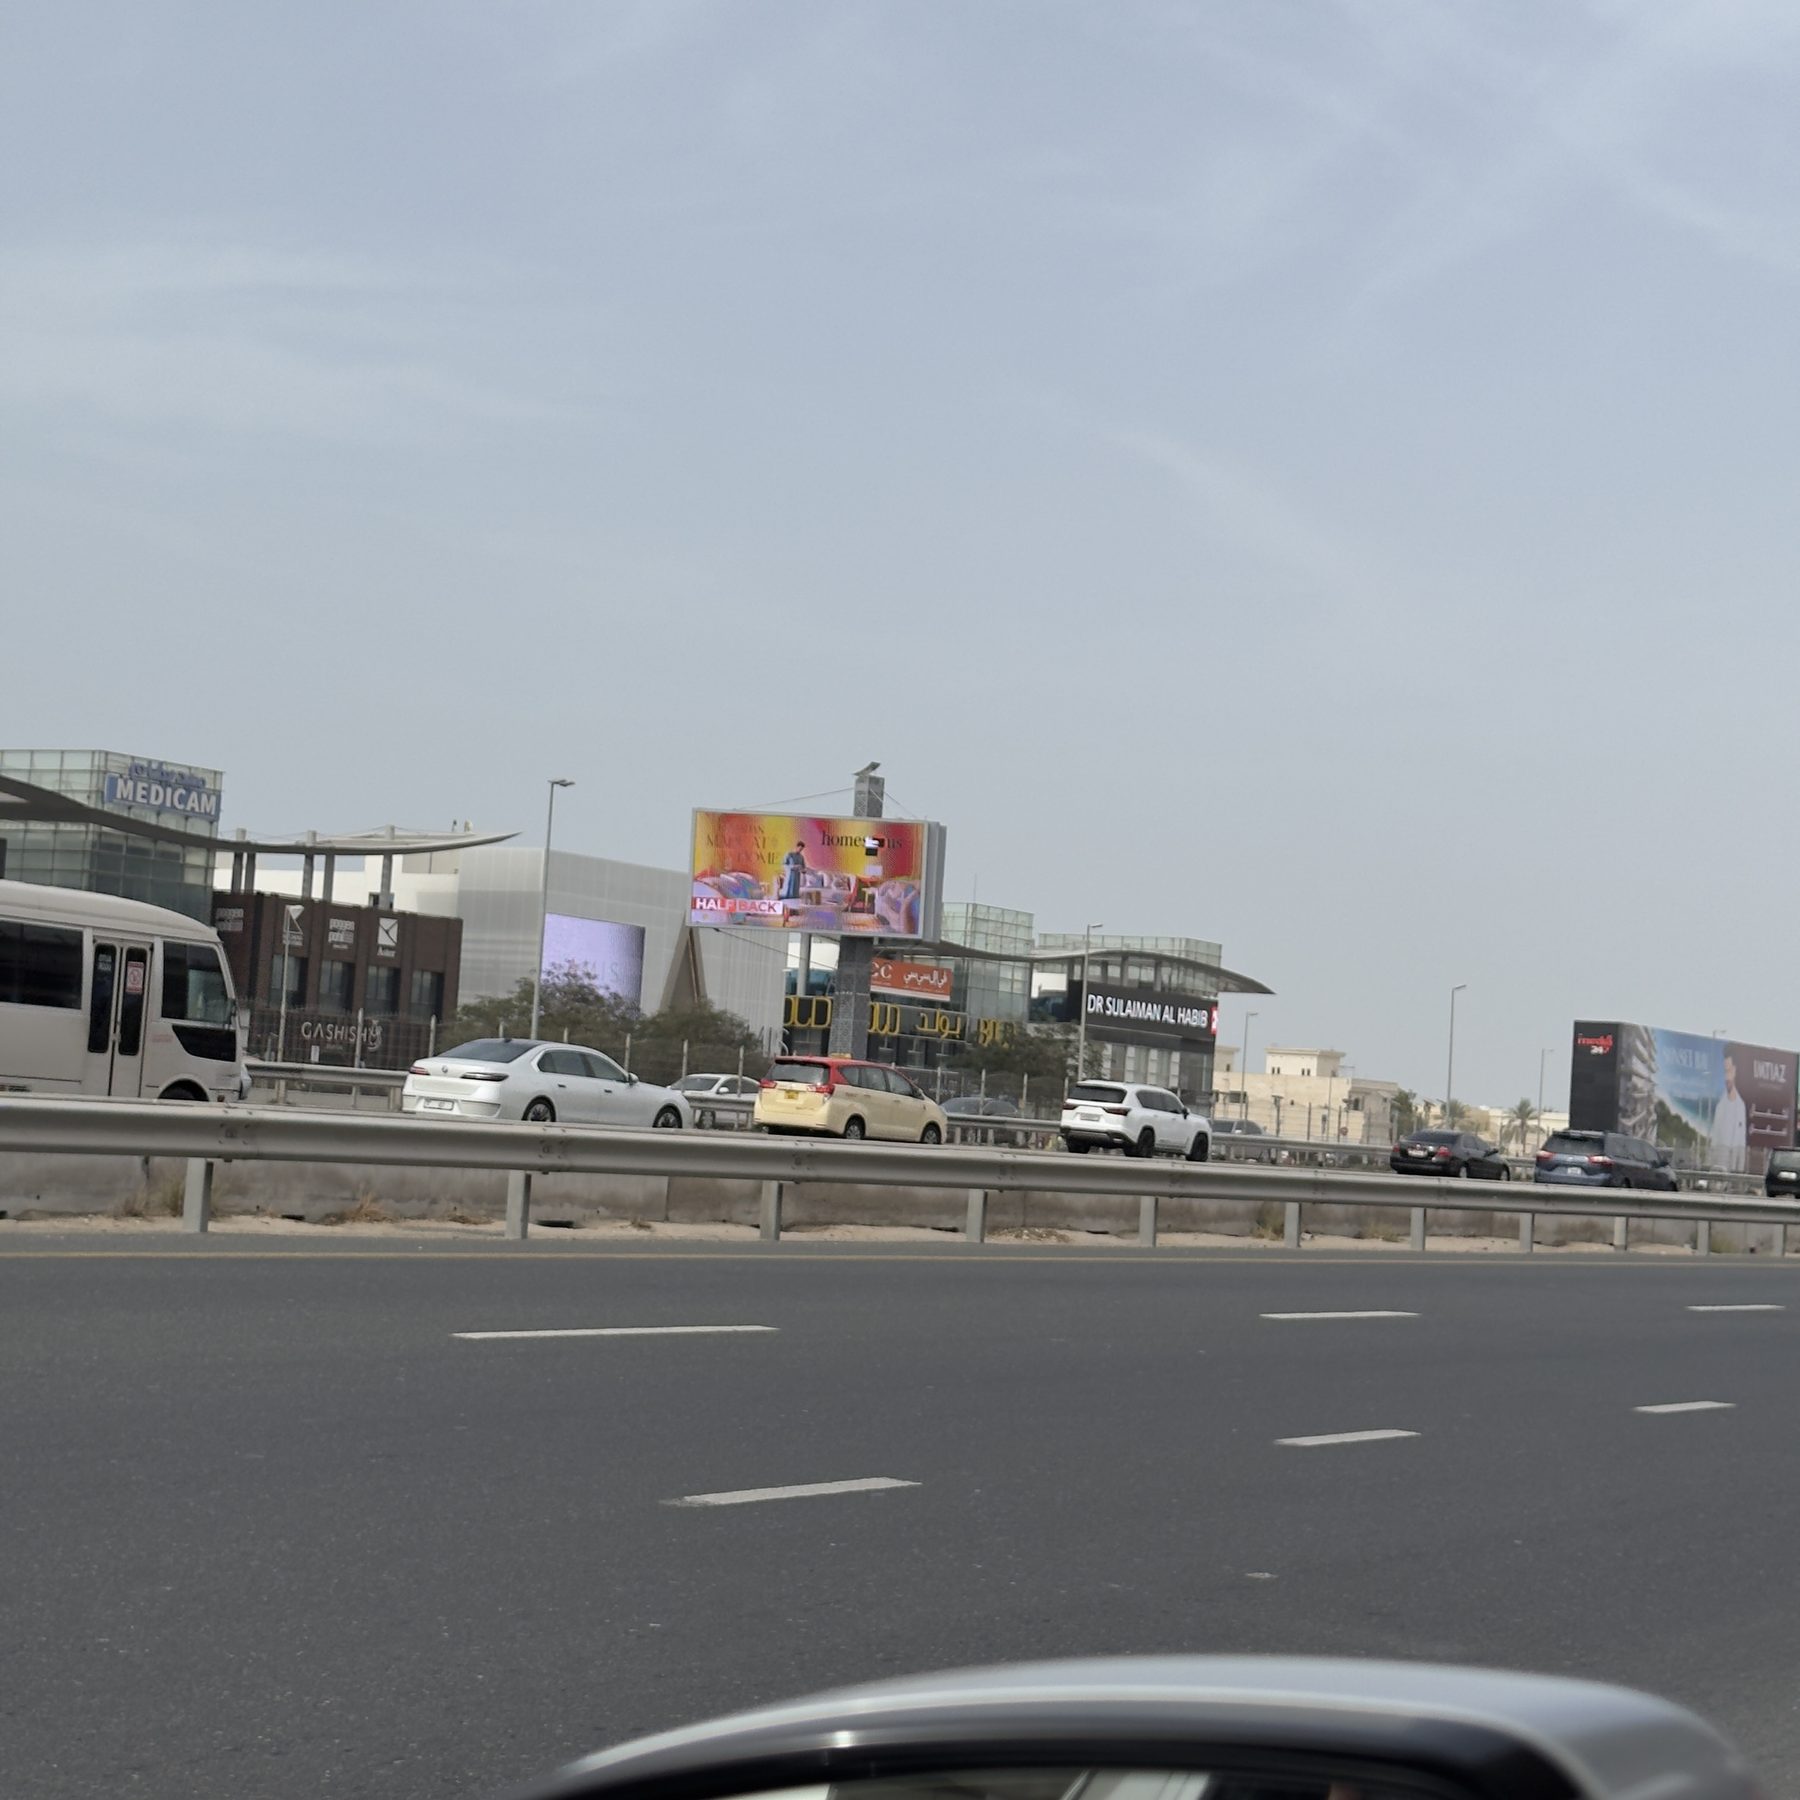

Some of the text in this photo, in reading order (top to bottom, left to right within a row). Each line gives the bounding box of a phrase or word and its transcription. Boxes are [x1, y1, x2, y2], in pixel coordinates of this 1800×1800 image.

[116, 778, 217, 815] MEDICAM
[739, 900, 778, 913] BACK
[1087, 994, 1208, 1028] DR SULAIMAN AL HABIB
